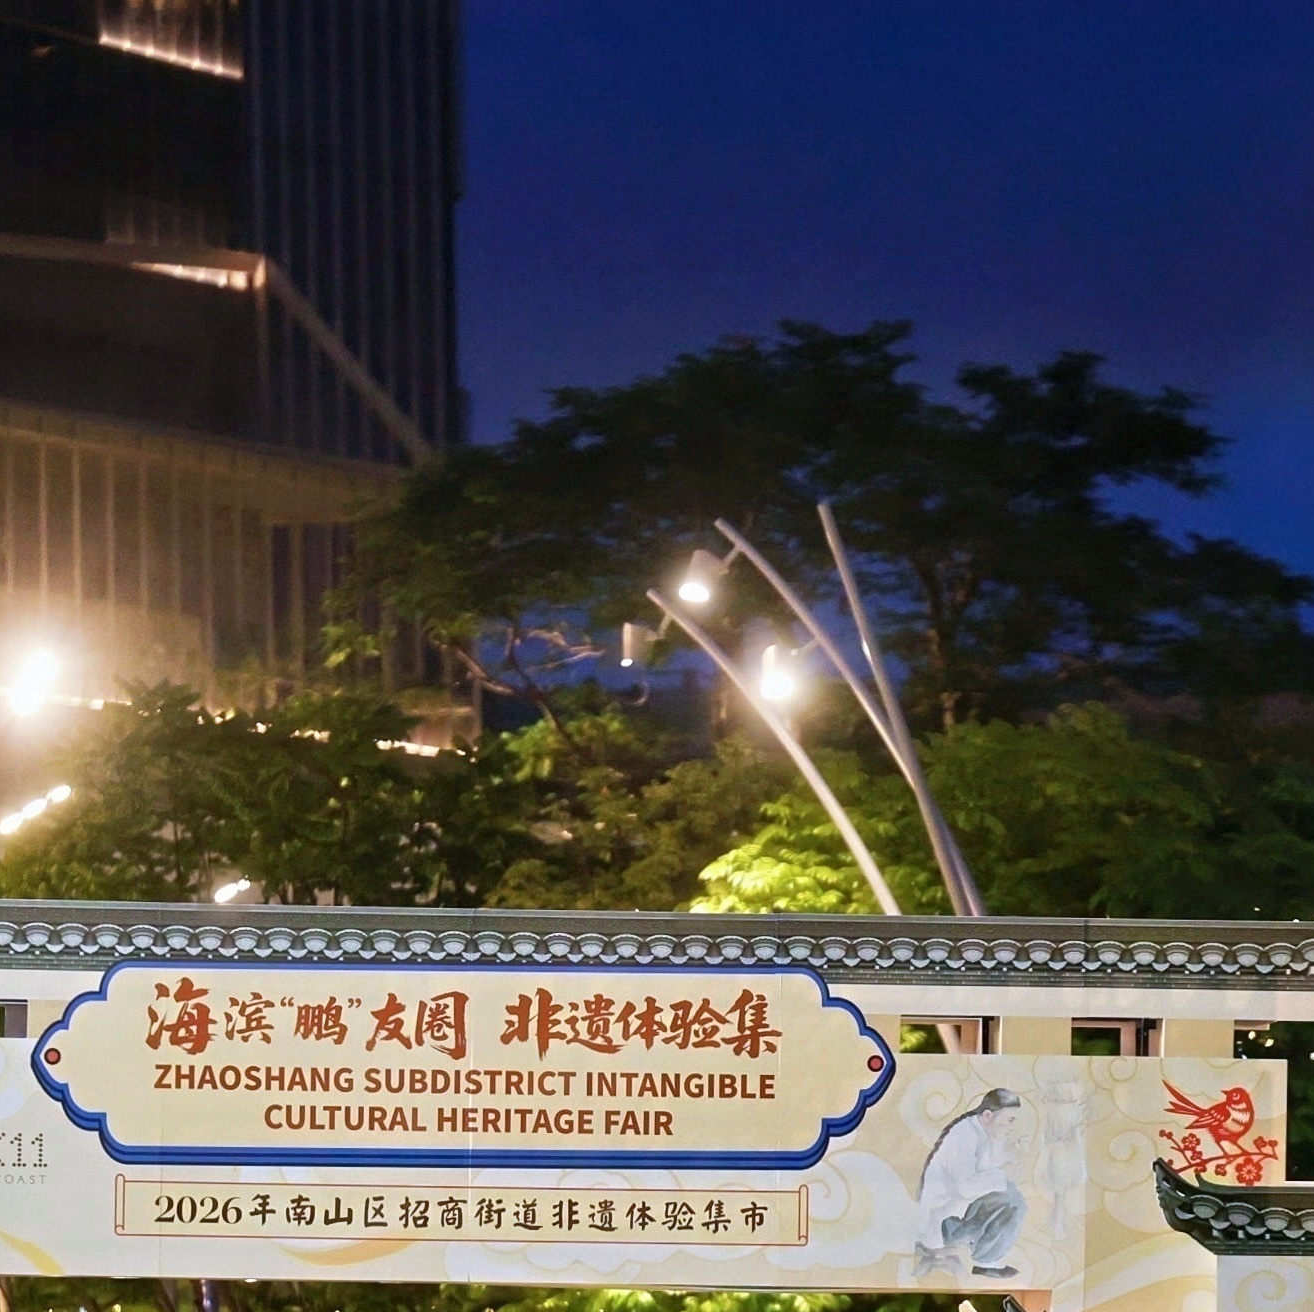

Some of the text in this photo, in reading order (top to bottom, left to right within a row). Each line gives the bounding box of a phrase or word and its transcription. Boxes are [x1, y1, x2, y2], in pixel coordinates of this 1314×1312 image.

[145, 976, 782, 1061] 海滨“鹏”友圈 非遗体验集
[153, 1064, 776, 1099] ZHAOSHANG SUBDISTRICT INTANGIBLE
[264, 1103, 674, 1136] CULTURAL HERITAGE FAIR
[154, 1193, 770, 1234] 2026年南山区招商街道非遗体验集市
